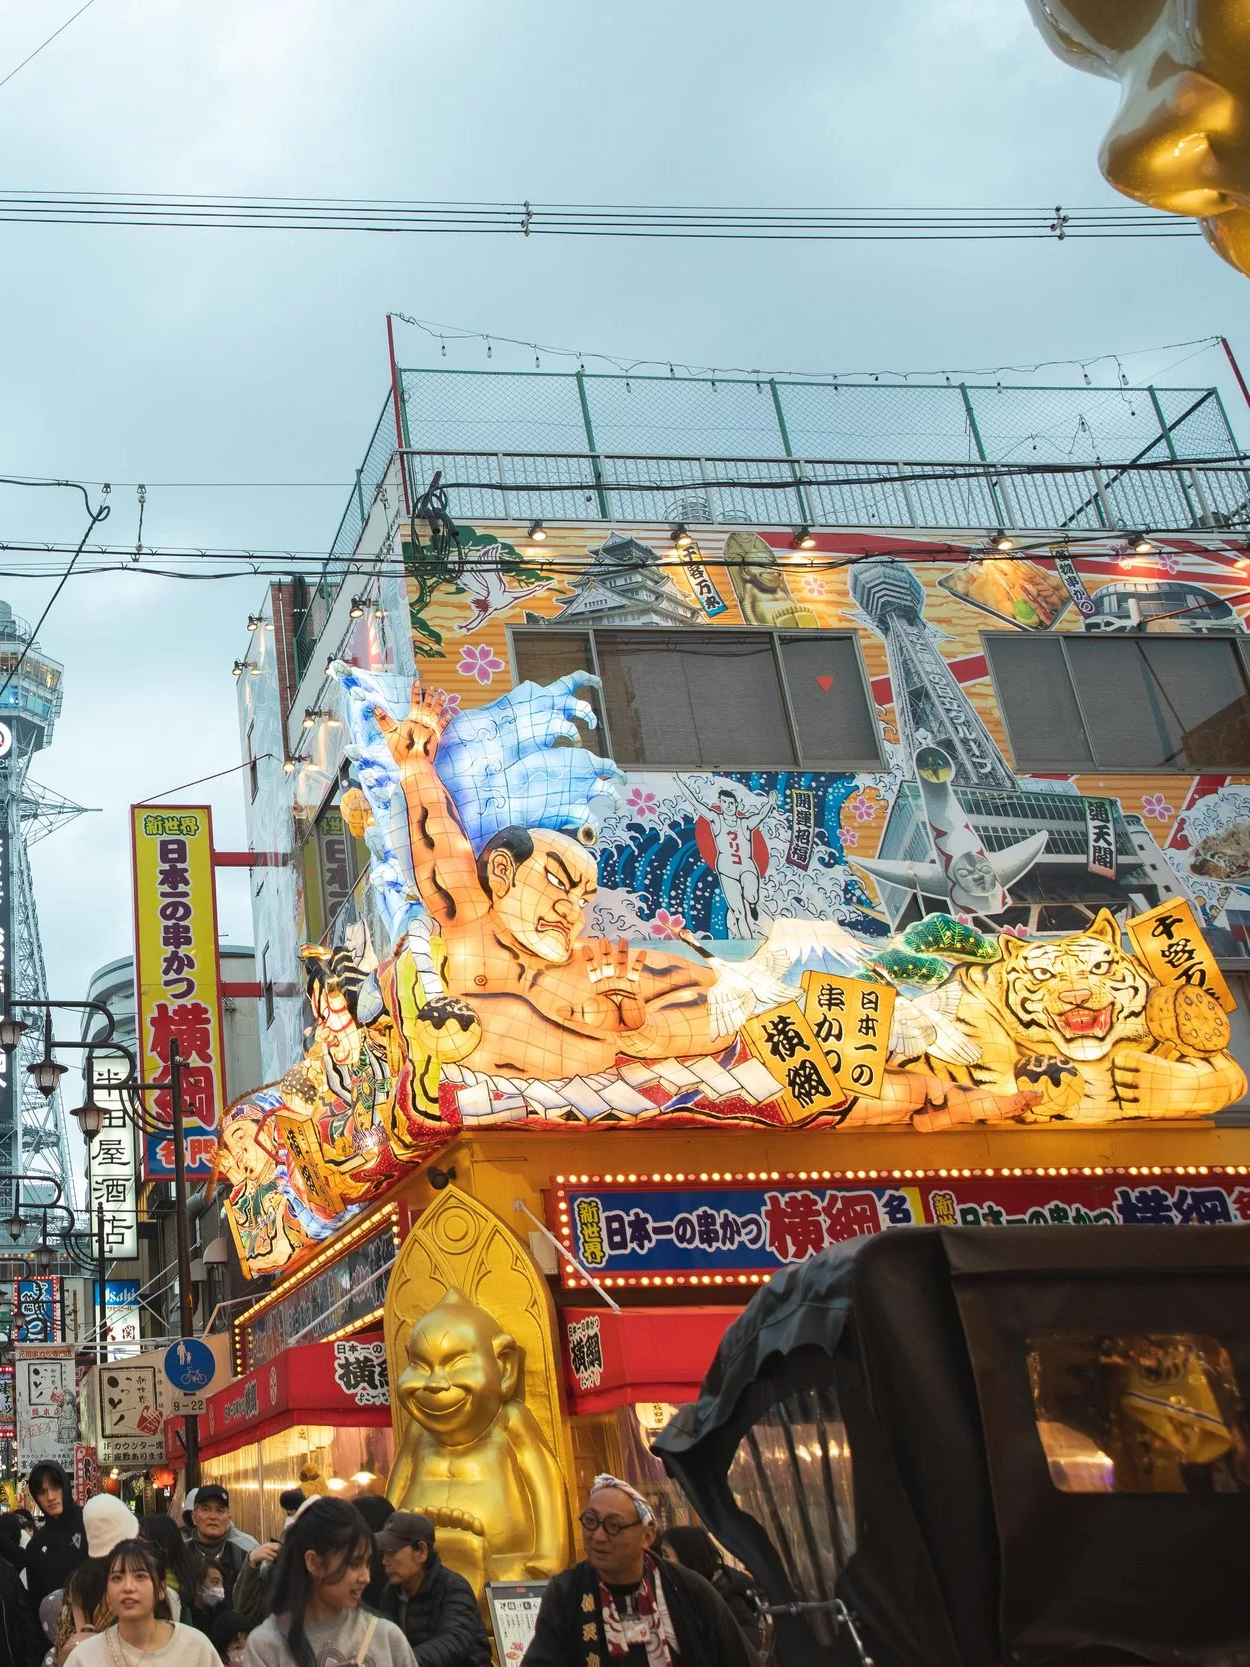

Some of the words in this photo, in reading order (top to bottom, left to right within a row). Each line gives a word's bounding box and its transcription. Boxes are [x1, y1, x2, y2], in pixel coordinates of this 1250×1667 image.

[144, 815, 200, 837] 新世界
[726, 830, 742, 866] グリコ
[1088, 801, 1113, 869] 通天閣
[158, 838, 196, 1000] 日本一の串かつ
[1151, 914, 1222, 1003] 千客万
[149, 1002, 217, 1131] 横綱
[761, 1014, 832, 1109] 横綱
[851, 990, 880, 1087] 日本一の
[579, 1200, 606, 1265] 新世界
[605, 1211, 762, 1252] 日本一の串かつ
[764, 1192, 883, 1261] 横綱
[337, 1344, 383, 1355] 日本一の
[103, 1442, 111, 1450] 1F
[103, 1453, 111, 1461] 2F
